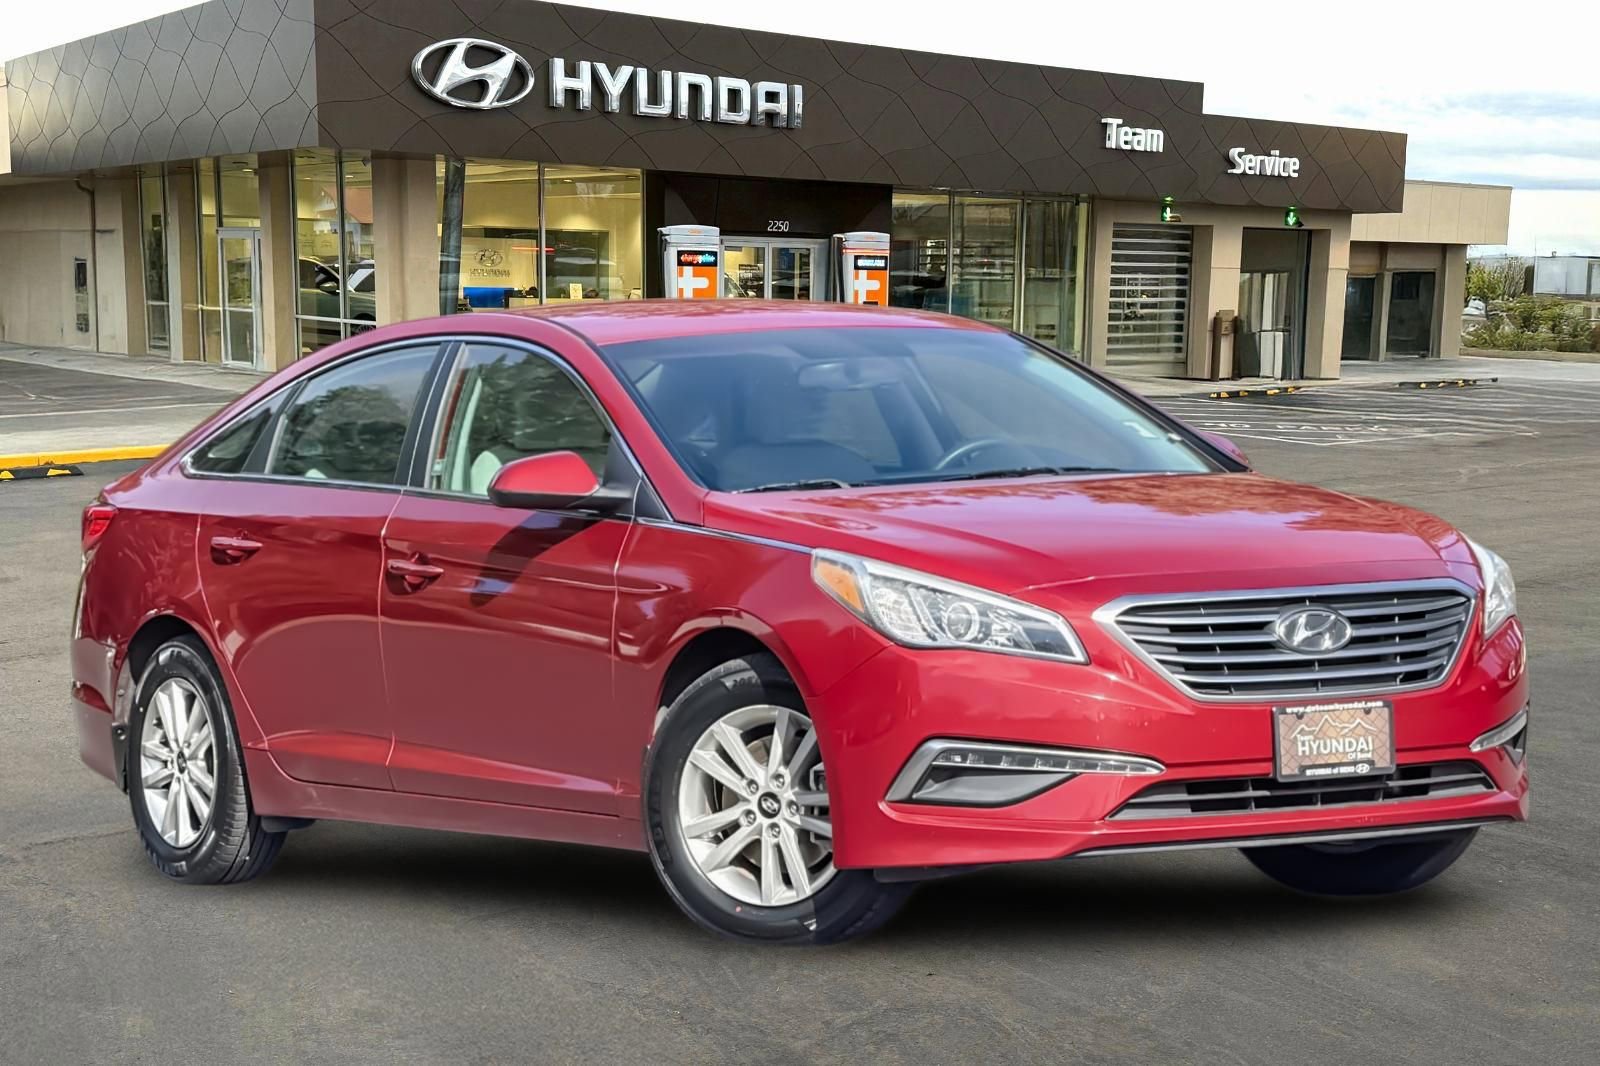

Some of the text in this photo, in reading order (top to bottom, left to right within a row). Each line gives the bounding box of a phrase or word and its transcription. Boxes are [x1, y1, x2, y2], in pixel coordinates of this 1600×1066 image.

[549, 57, 803, 129] HYUNDAI
[1101, 117, 1164, 152] Team
[1227, 147, 1300, 178] Service
[767, 220, 790, 232] 2250
[1298, 736, 1373, 756] HYUNDAI
